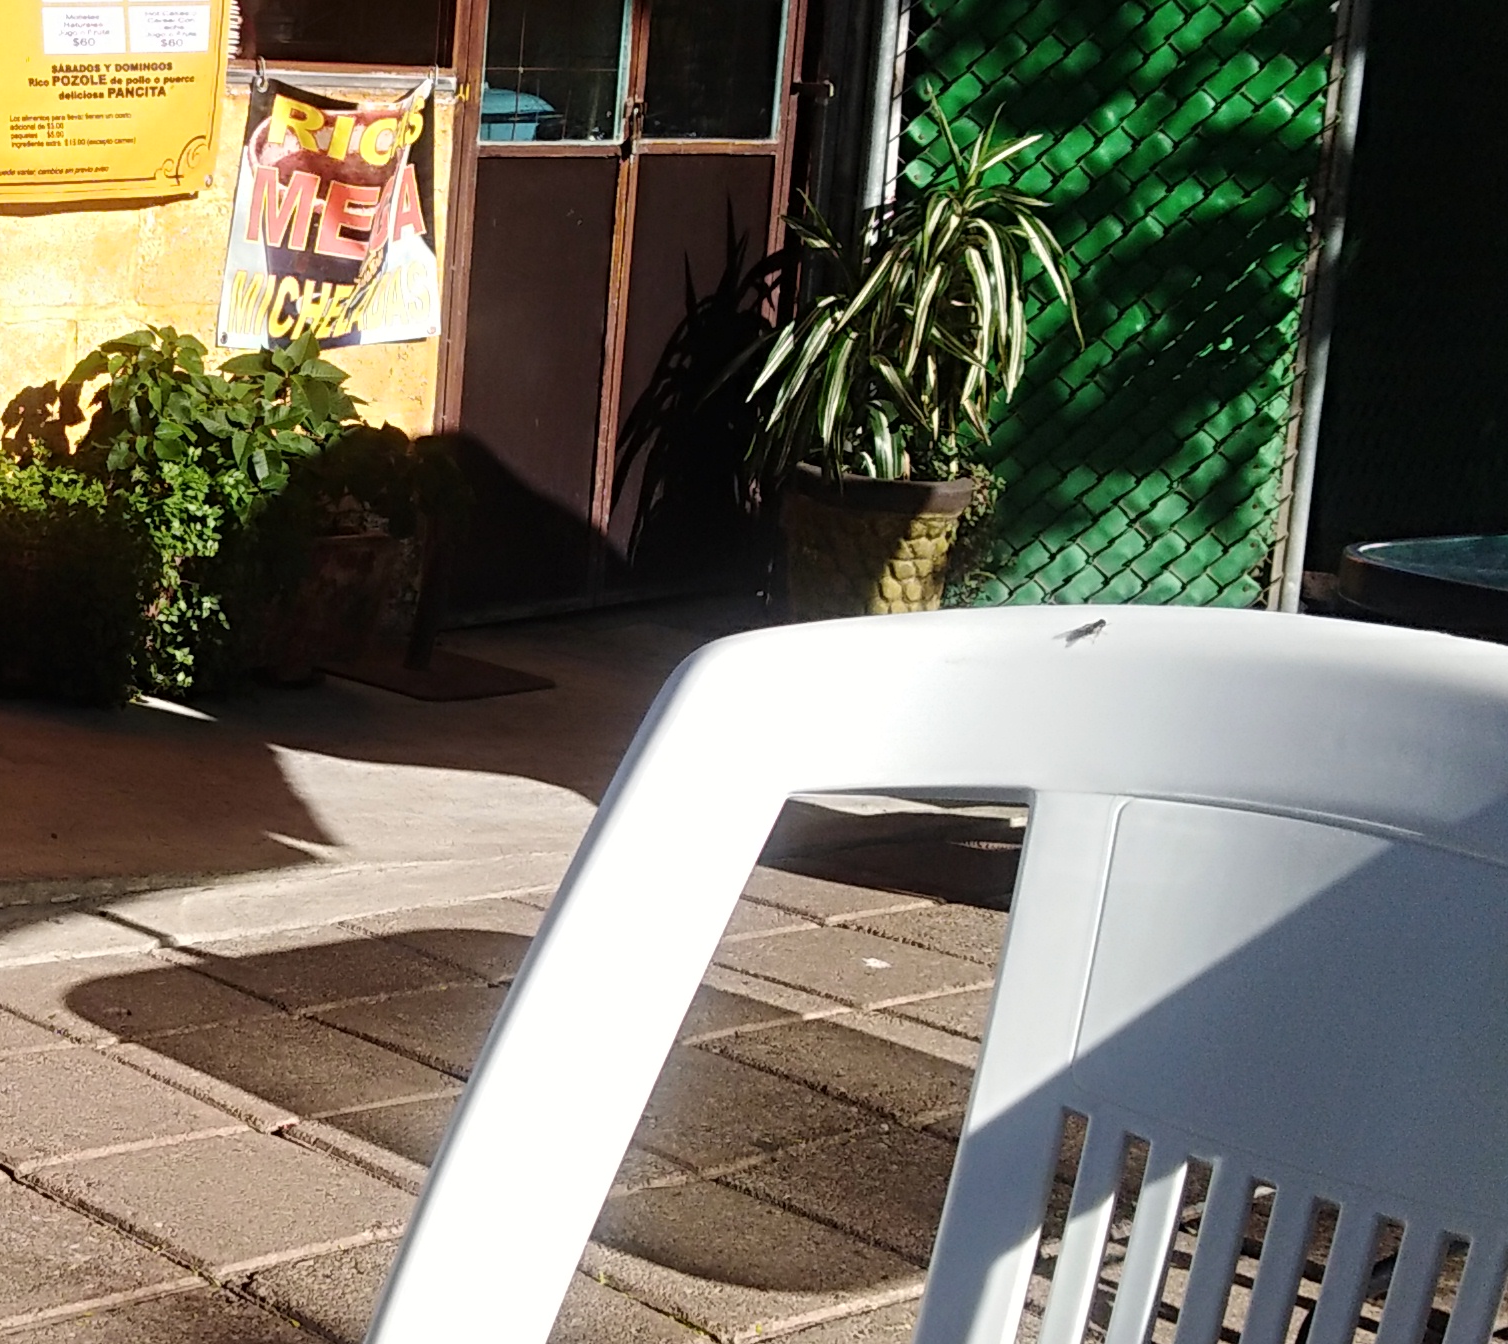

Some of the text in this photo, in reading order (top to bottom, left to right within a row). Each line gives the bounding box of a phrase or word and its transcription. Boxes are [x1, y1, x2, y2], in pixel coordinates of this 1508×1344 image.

[104, 63, 111, 71] Y
[115, 62, 172, 71] DOMINGOS
[28, 78, 49, 87] Rico
[52, 74, 107, 86] POZOLE
[126, 76, 151, 86] pollo
[163, 75, 194, 84] puerco
[59, 86, 166, 100] deliciosa PANCITA
